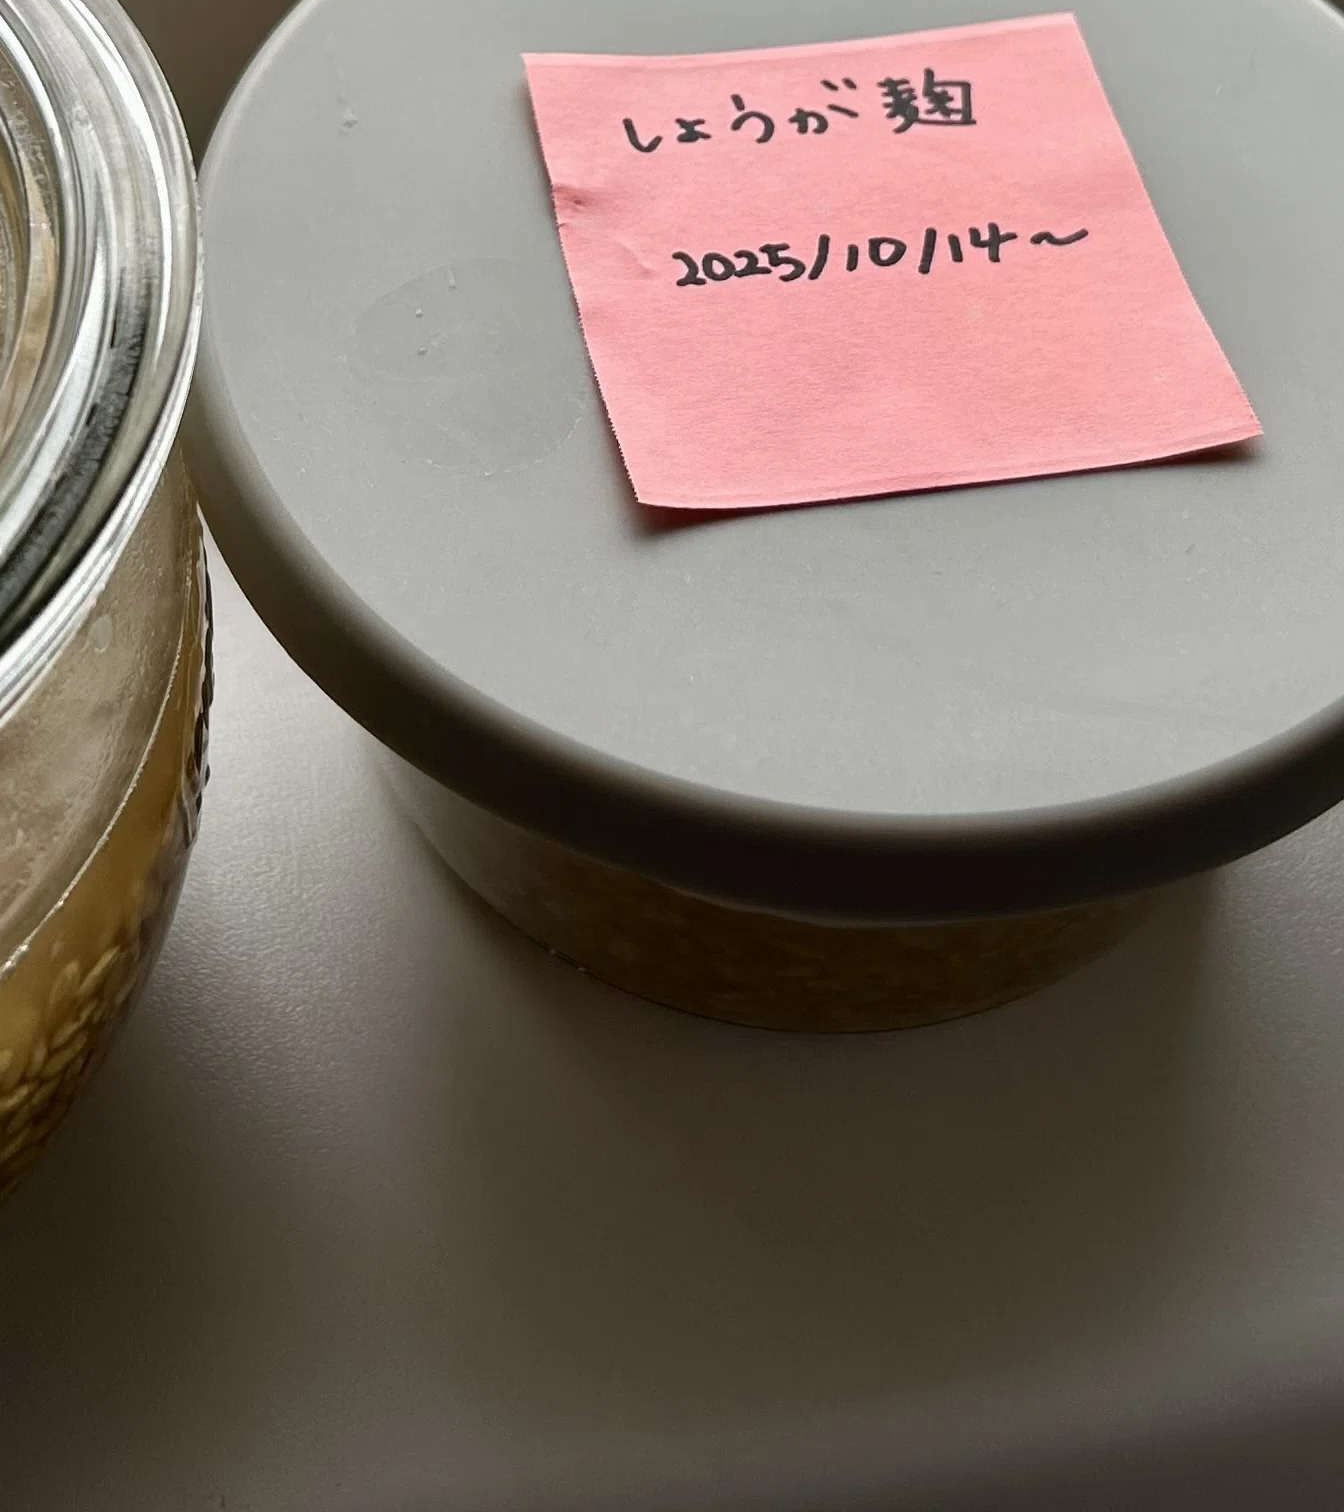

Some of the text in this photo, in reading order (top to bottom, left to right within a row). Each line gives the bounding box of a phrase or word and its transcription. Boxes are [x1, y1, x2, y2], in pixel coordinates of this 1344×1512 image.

[622, 67, 977, 154] しょうが麹
